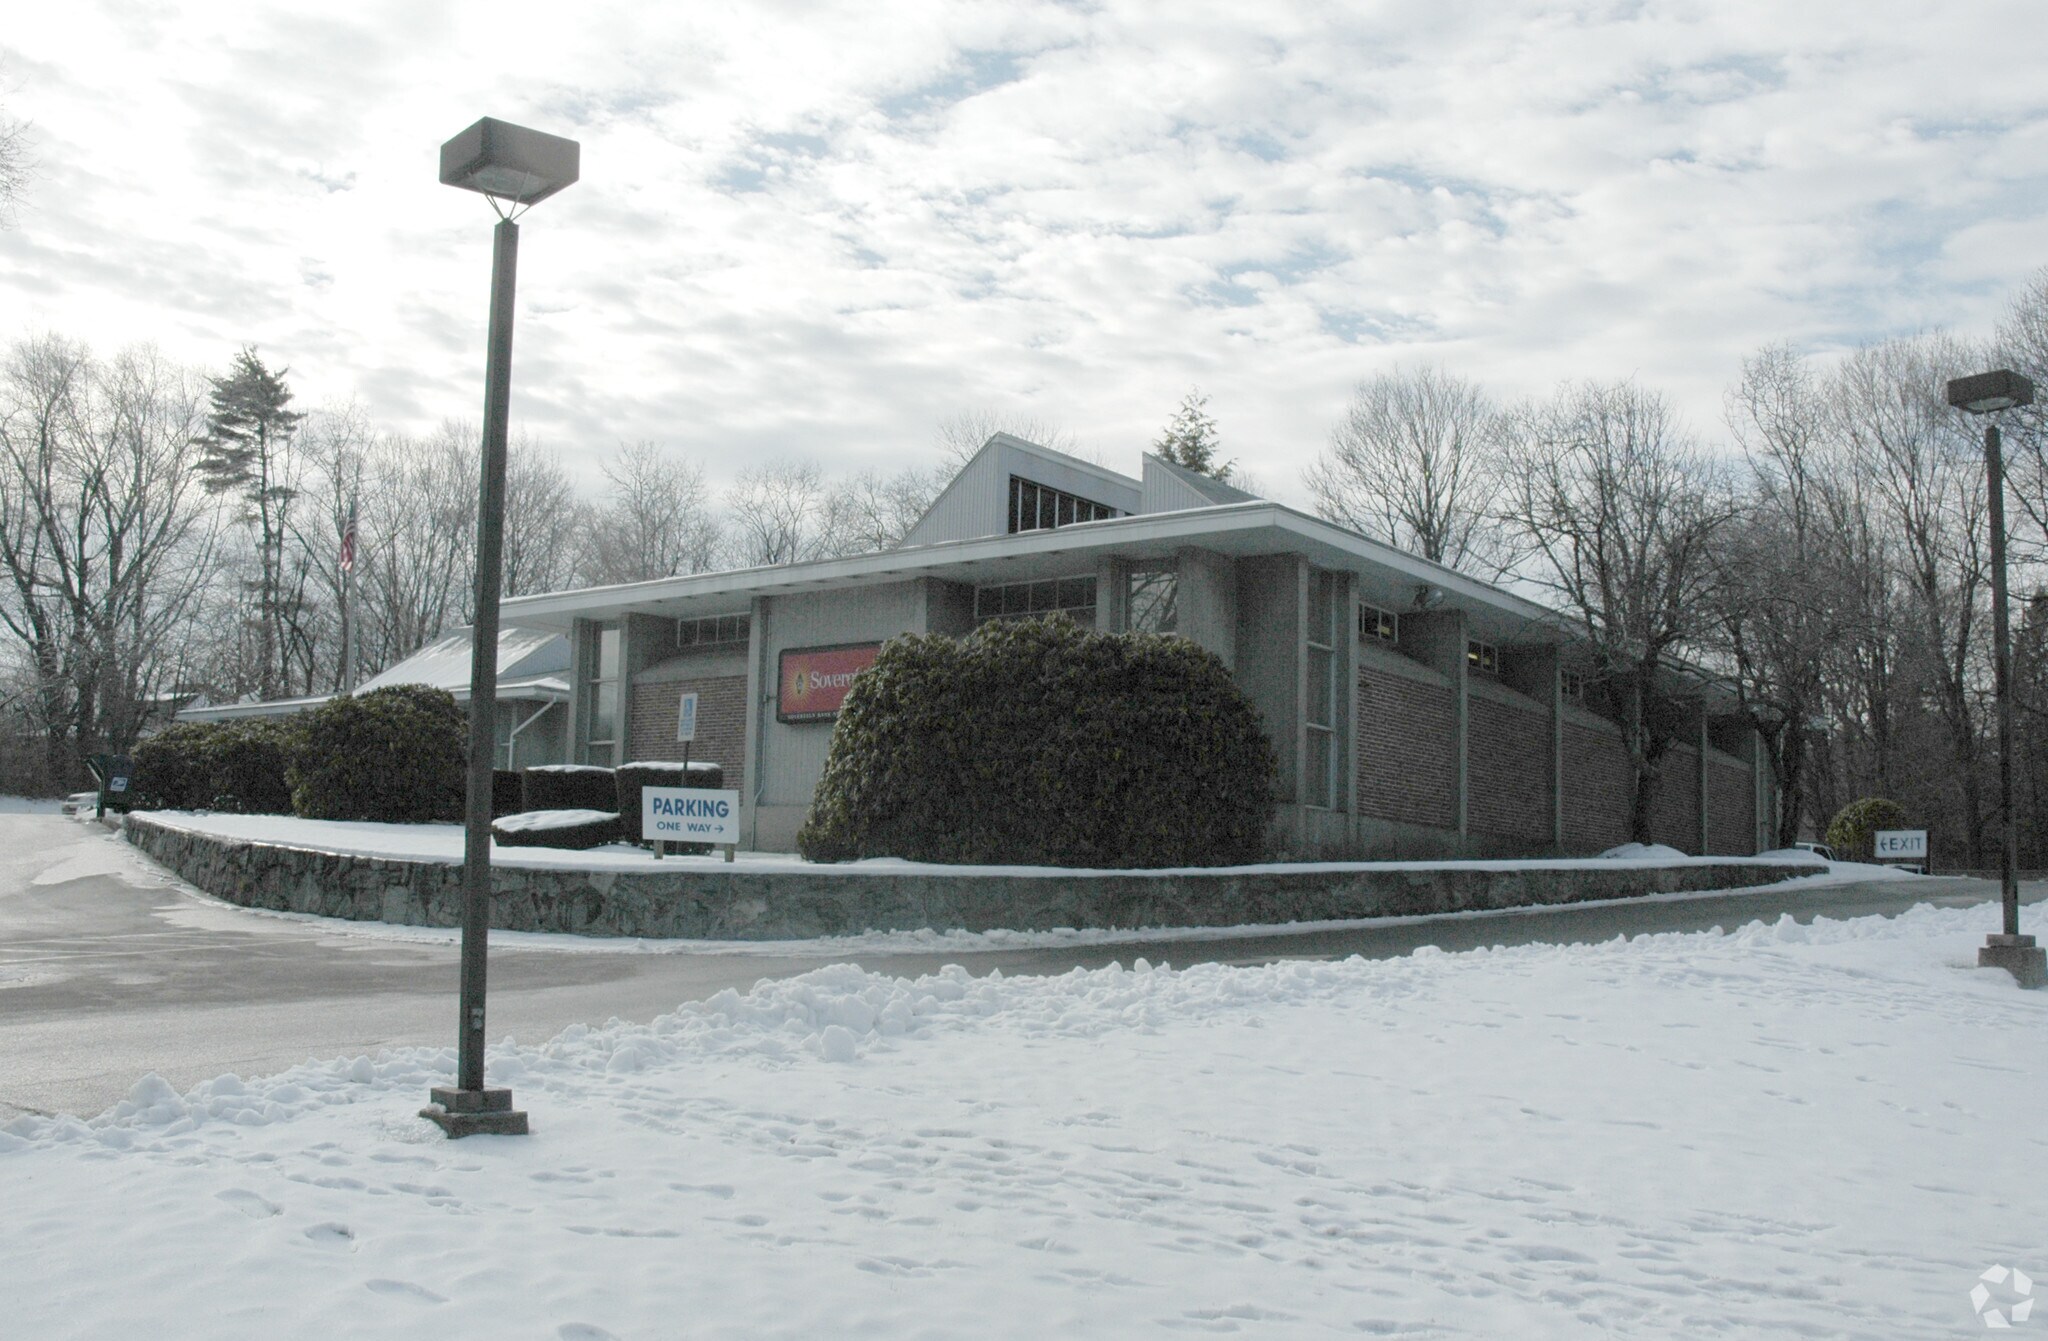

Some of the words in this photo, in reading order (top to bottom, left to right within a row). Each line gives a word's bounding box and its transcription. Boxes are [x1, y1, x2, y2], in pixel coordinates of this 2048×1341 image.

[810, 669, 858, 689] Sovere
[653, 797, 729, 818] PARKING
[656, 821, 680, 831] ONE
[687, 822, 711, 832] WAY
[1889, 838, 1921, 850] EXIT
